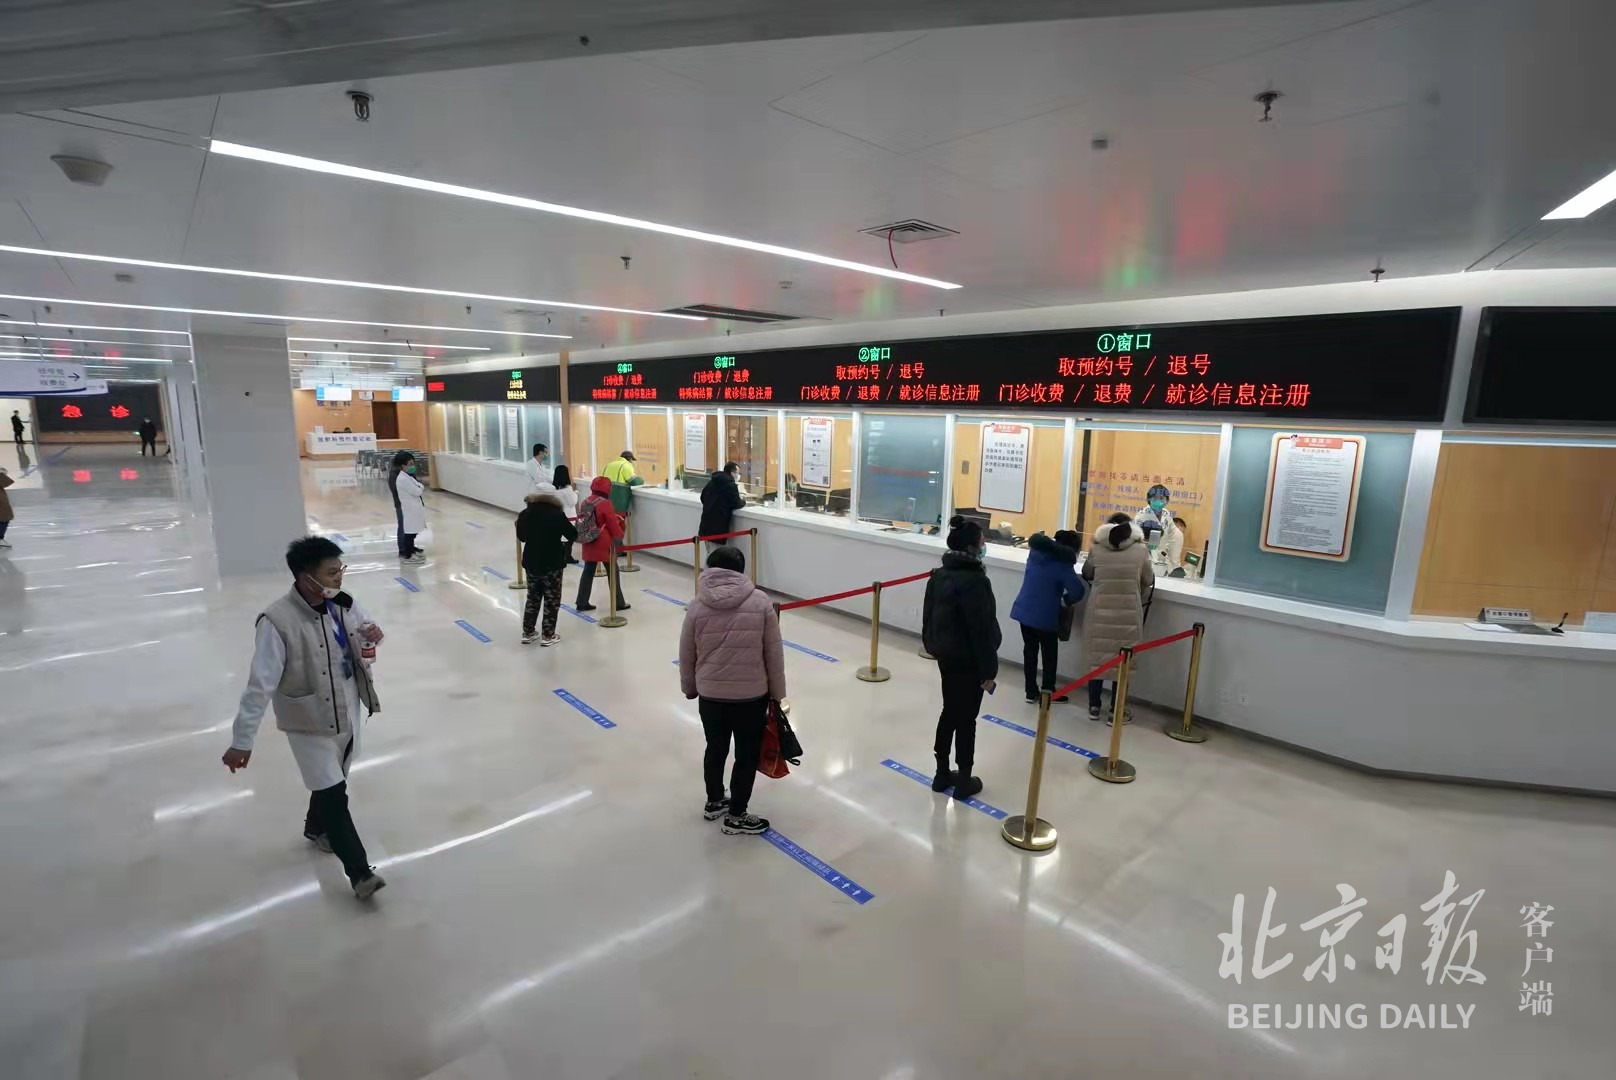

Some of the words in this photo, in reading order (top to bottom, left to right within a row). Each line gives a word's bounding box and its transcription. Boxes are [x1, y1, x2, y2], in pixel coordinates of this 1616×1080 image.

[836, 364, 880, 380] 取预约号
[899, 362, 925, 379] 退号
[1058, 355, 1133, 376] 取预约号
[1167, 354, 1211, 376] 退号
[724, 386, 772, 400] 就诊信息注册
[801, 385, 840, 400] 门诊收费
[857, 385, 880, 400] 退费
[899, 383, 980, 402] 就诊信息注册
[999, 383, 1064, 402] 门诊收费
[1094, 383, 1132, 403] 退费
[1165, 382, 1311, 406] 就诊信息注册
[61, 403, 130, 419] 急诊
